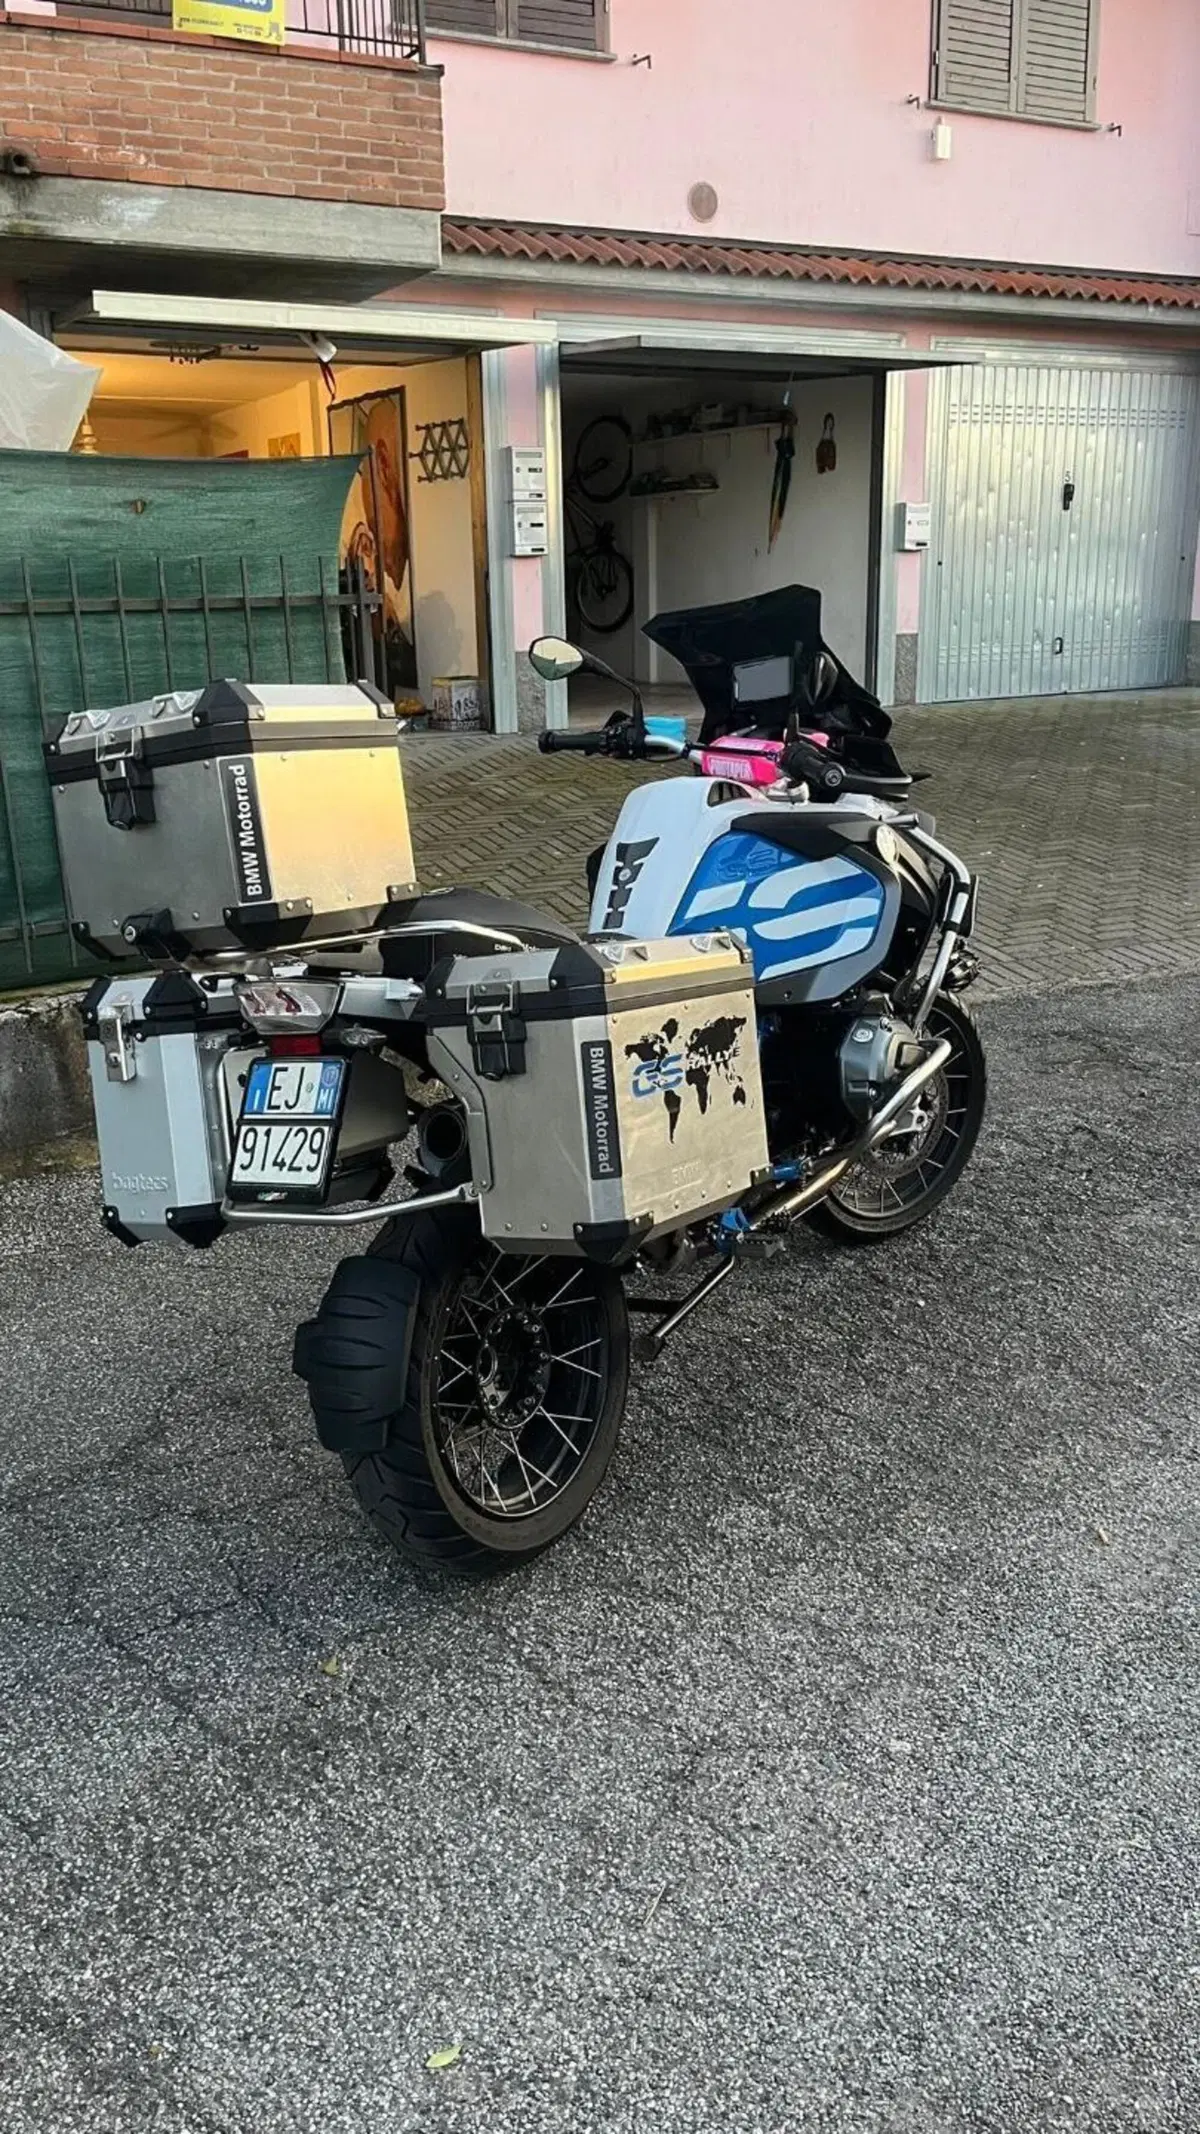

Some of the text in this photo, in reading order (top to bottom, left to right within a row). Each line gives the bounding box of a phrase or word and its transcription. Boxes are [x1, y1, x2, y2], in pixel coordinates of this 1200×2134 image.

[228, 764, 263, 896] BMW Motorrad
[631, 1053, 684, 1099] GS
[686, 1045, 741, 1071] RALLYE
[266, 1066, 305, 1110] EJ
[317, 1087, 335, 1110] MI
[590, 1047, 614, 1173] BMW Motorrad
[239, 1126, 326, 1173] 91429
